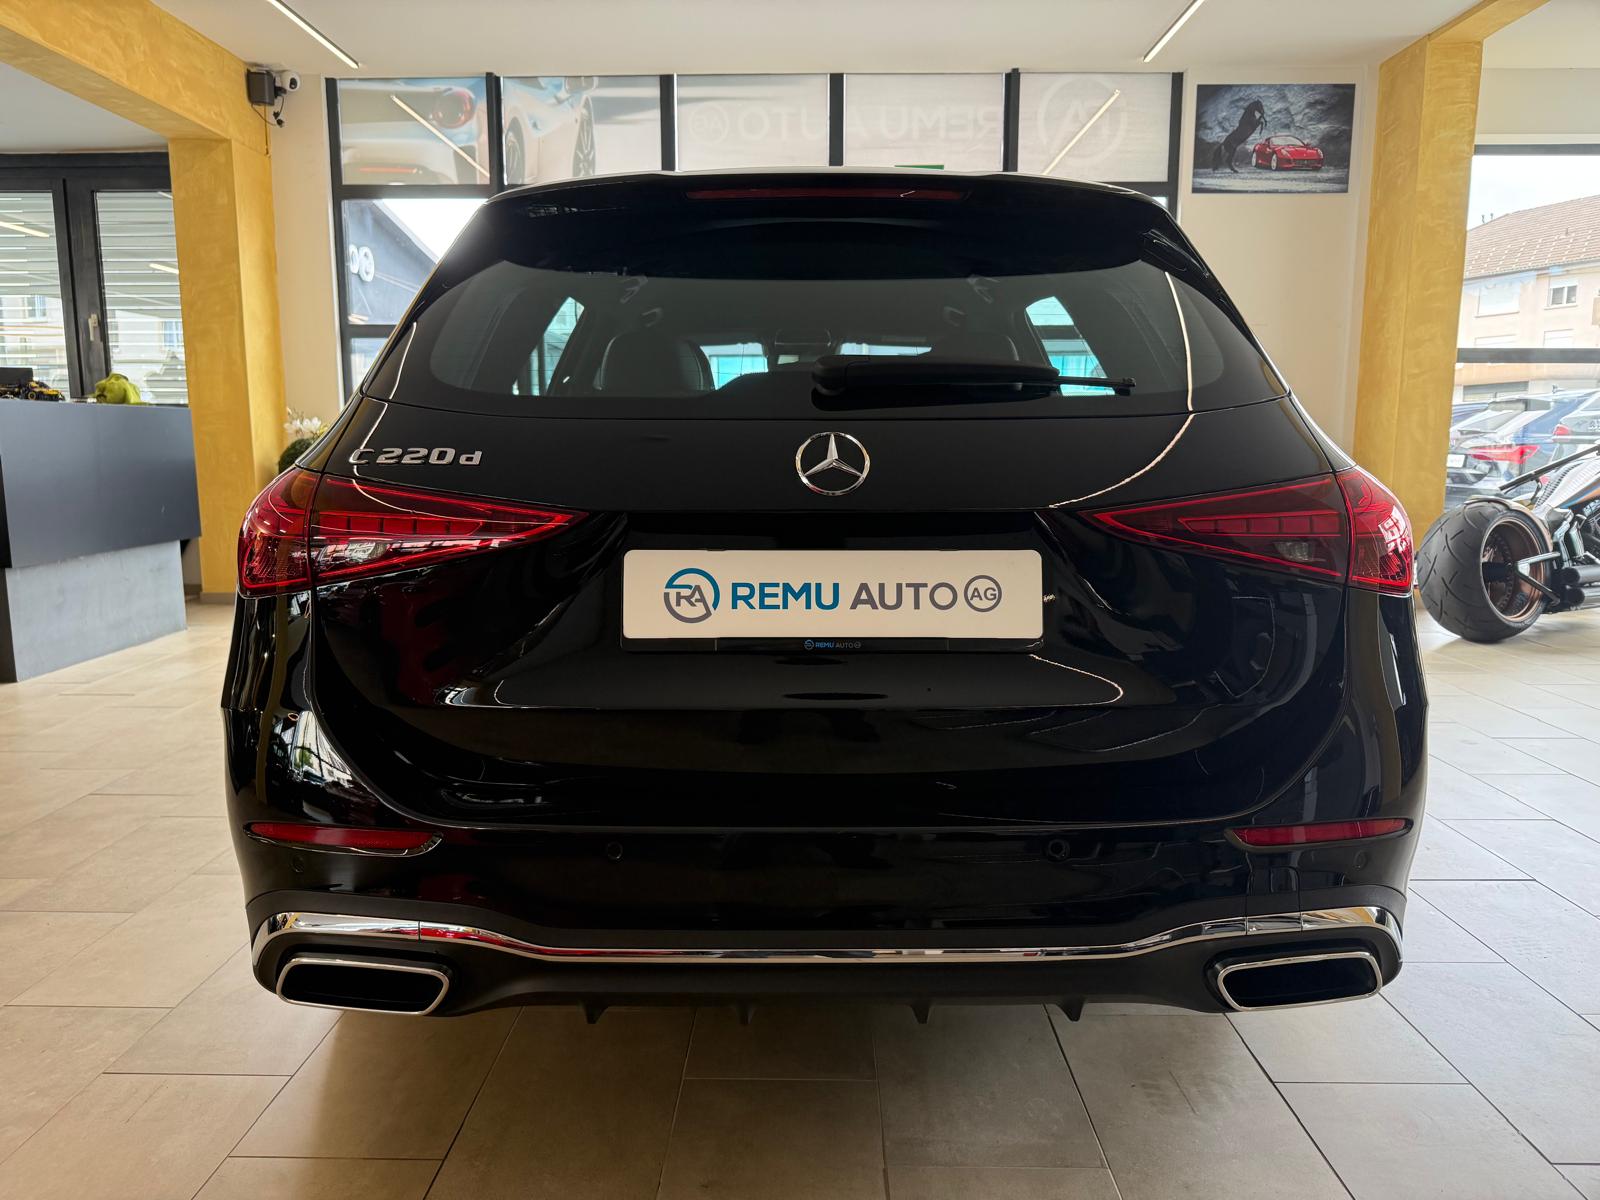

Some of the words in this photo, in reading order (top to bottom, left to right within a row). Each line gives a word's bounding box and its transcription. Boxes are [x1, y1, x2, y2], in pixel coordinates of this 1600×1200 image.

[349, 447, 375, 465] C
[376, 447, 456, 465] 220
[459, 450, 483, 465] d
[732, 582, 840, 610] REMU
[849, 582, 958, 610] AUTO
[968, 586, 997, 602] AG
